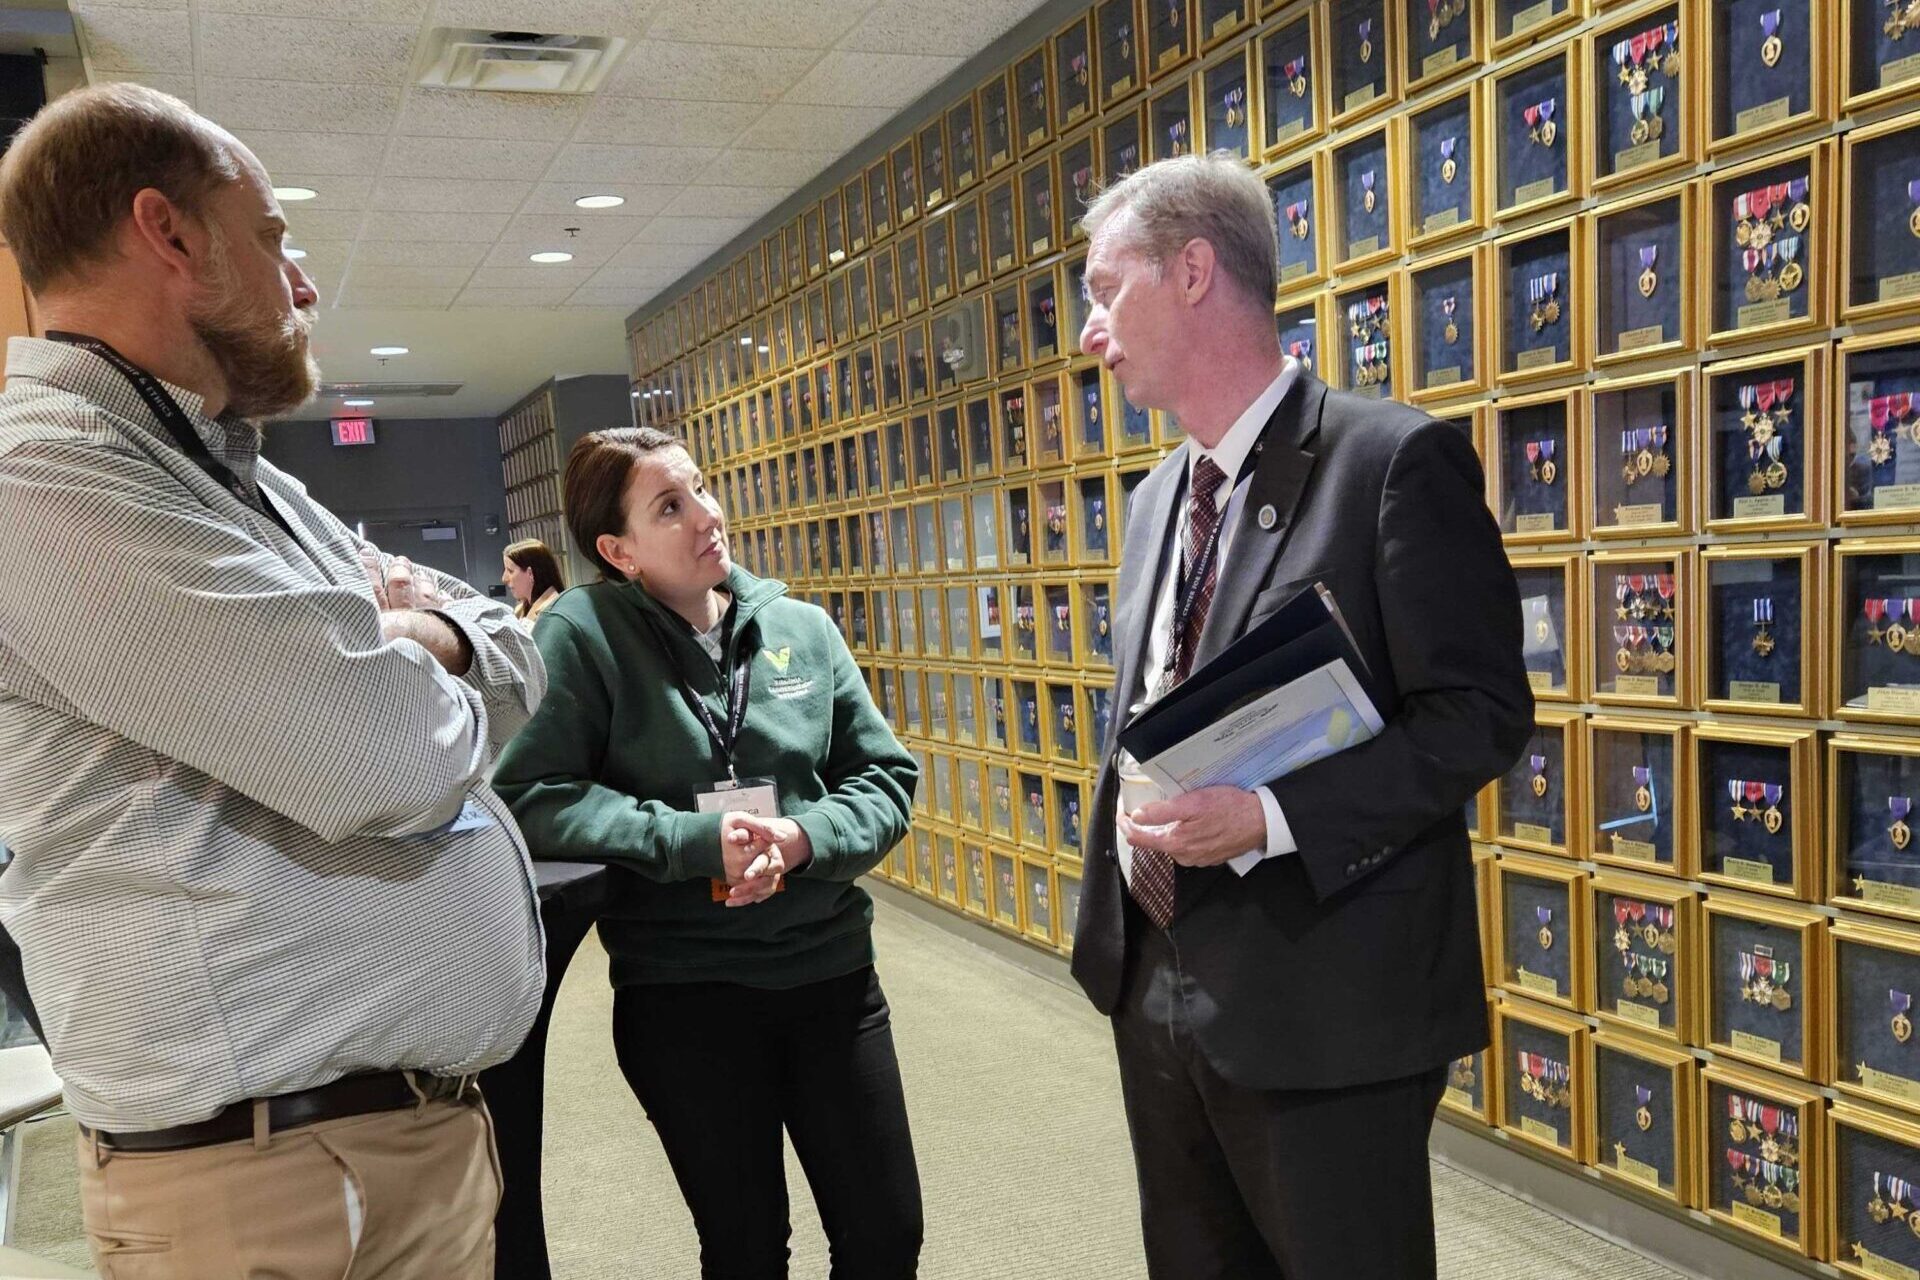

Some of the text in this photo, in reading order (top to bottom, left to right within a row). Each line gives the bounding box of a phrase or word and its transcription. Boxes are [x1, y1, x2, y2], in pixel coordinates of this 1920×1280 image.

[146, 386, 174, 417] ETHICS
[338, 421, 367, 443] EXIT
[1182, 590, 1195, 617] CENTER
[1192, 575, 1202, 590] FOR
[1197, 534, 1215, 575] LEADERSHIP
